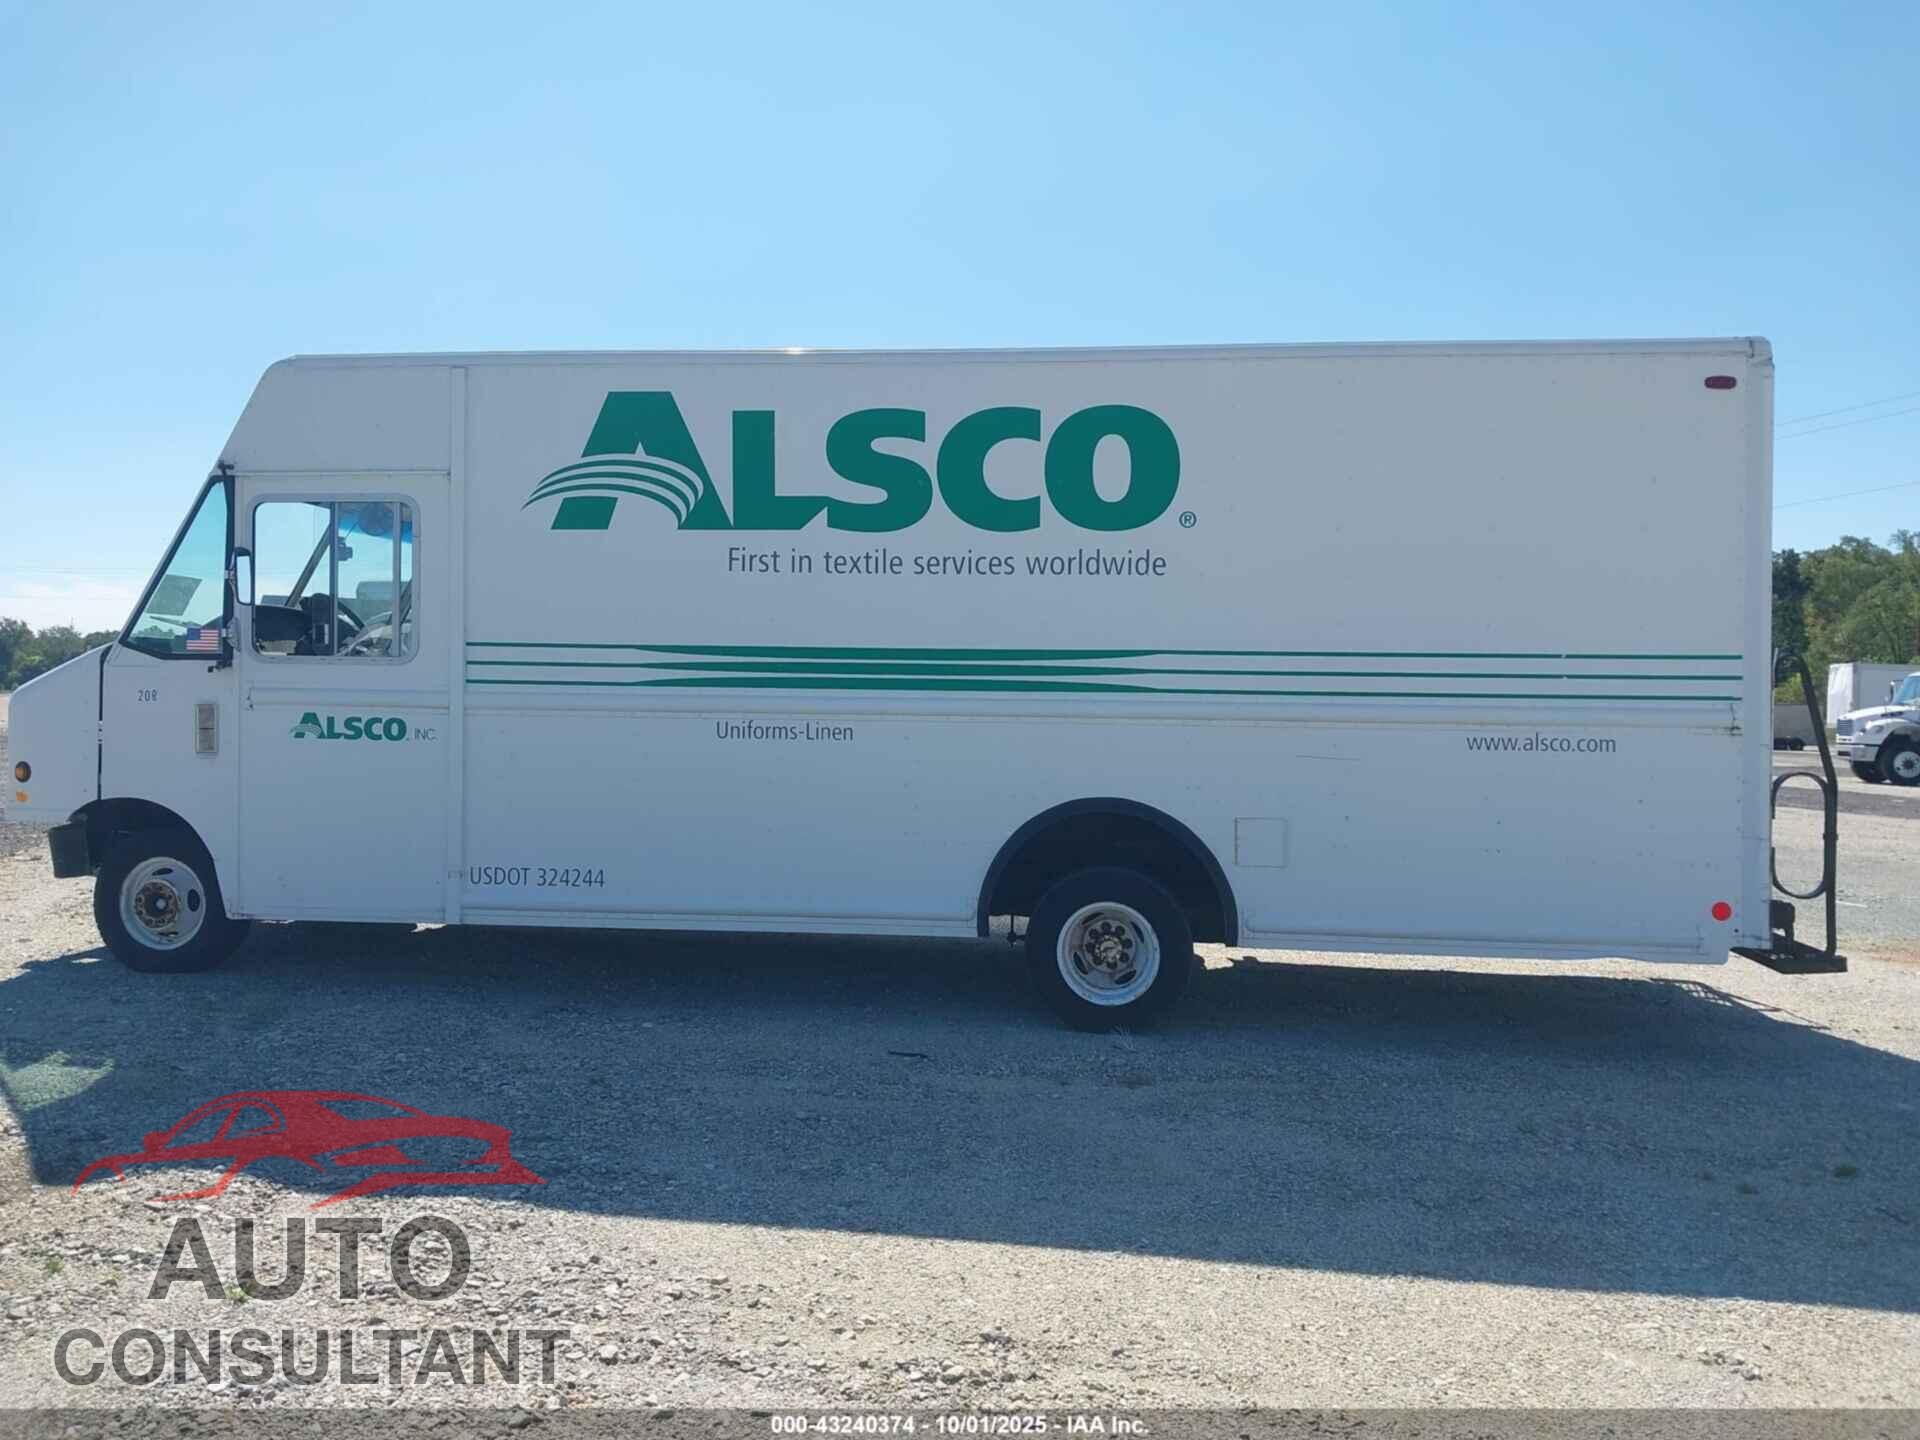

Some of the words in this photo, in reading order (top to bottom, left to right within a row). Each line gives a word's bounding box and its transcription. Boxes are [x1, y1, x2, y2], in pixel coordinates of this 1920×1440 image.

[522, 390, 1181, 532] ALSCO
[728, 547, 780, 573] First
[791, 548, 812, 573] in
[824, 548, 903, 575] textile
[913, 549, 1015, 576] services
[1025, 549, 1167, 576] worldwide
[716, 720, 854, 741] Uniforms-Linen
[1465, 731, 1617, 753] www.alsco.com
[470, 867, 530, 885] USDOT
[537, 868, 605, 887] 324244
